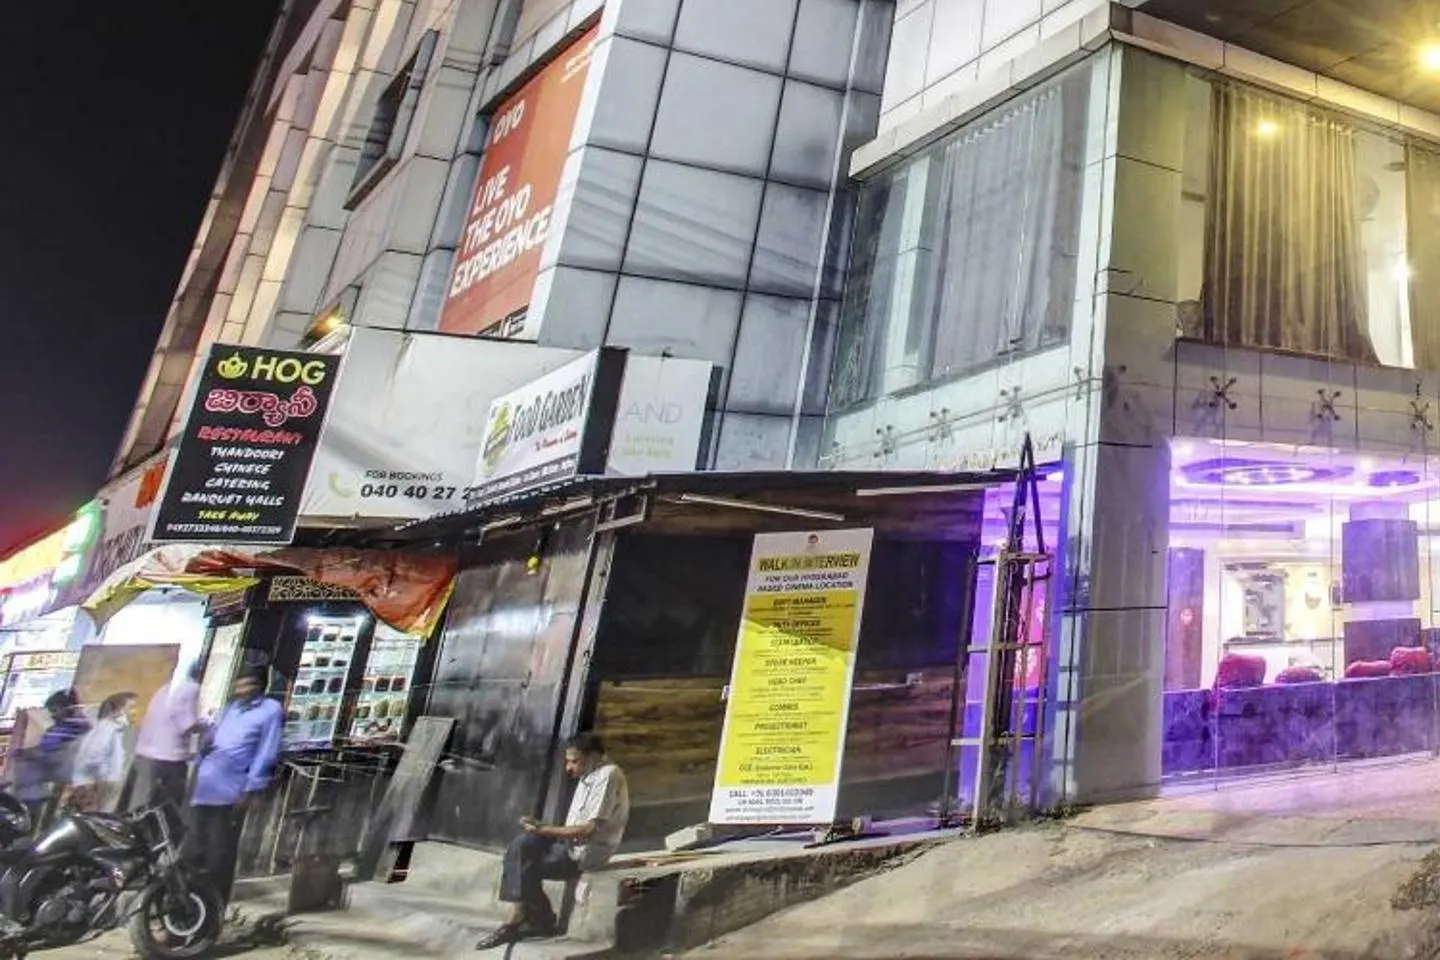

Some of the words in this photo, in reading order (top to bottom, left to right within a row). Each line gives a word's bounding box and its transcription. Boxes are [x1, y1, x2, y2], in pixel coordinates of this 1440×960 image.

[494, 100, 525, 143] OYO
[473, 165, 510, 214] LIVE
[464, 207, 495, 254] THE
[495, 184, 532, 229] OYO
[449, 205, 552, 298] EXPERIENCE
[251, 356, 326, 385] HOG
[510, 395, 542, 443] FOOD
[539, 371, 592, 433] GARDEN
[197, 426, 303, 445] RESTAURANT
[205, 478, 271, 490] CATERING
[366, 470, 387, 480] FOR
[389, 471, 443, 482] BOOKINGS
[181, 492, 243, 505] BANQUET
[245, 495, 285, 506] HALLS
[360, 484, 398, 498] 040
[404, 485, 427, 500] 40
[432, 486, 457, 500] 27
[198, 510, 227, 520] TAKE
[228, 511, 260, 522] AWAY
